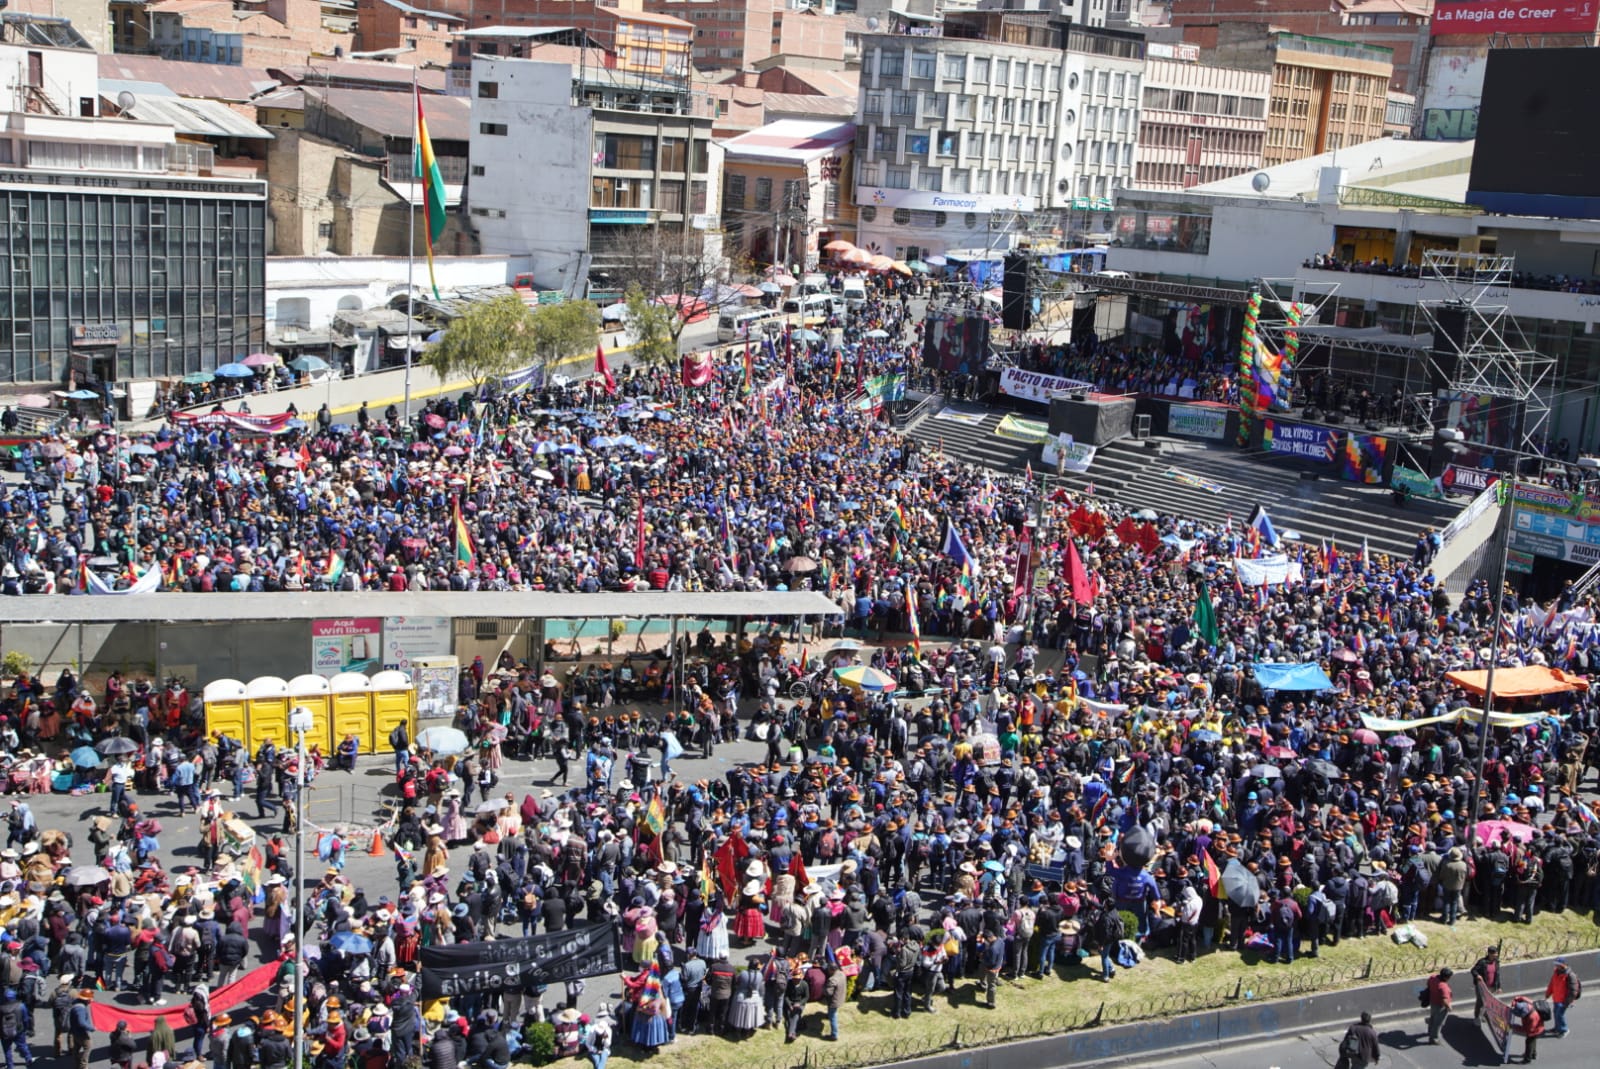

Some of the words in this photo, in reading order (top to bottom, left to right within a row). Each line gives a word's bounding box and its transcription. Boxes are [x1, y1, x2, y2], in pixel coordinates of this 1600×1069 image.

[1436, 9, 1452, 20] La
[1455, 7, 1495, 21] Magia
[1498, 7, 1515, 18] de
[1518, 7, 1556, 18] Creer
[0, 173, 34, 184] CASA
[47, 175, 62, 185] DE
[73, 176, 119, 188] RETIRO
[933, 196, 977, 209] Farmacorp
[1007, 369, 1042, 386] PACTO
[1041, 377, 1056, 389] DE
[1280, 426, 1314, 441] VOLVIMOS
[1316, 431, 1322, 442] Y
[1270, 438, 1291, 451] SOMOS
[1292, 442, 1326, 458] MILLONES
[1456, 471, 1487, 488] WILAS
[319, 627, 343, 635] Wifi
[318, 658, 340, 666] online
